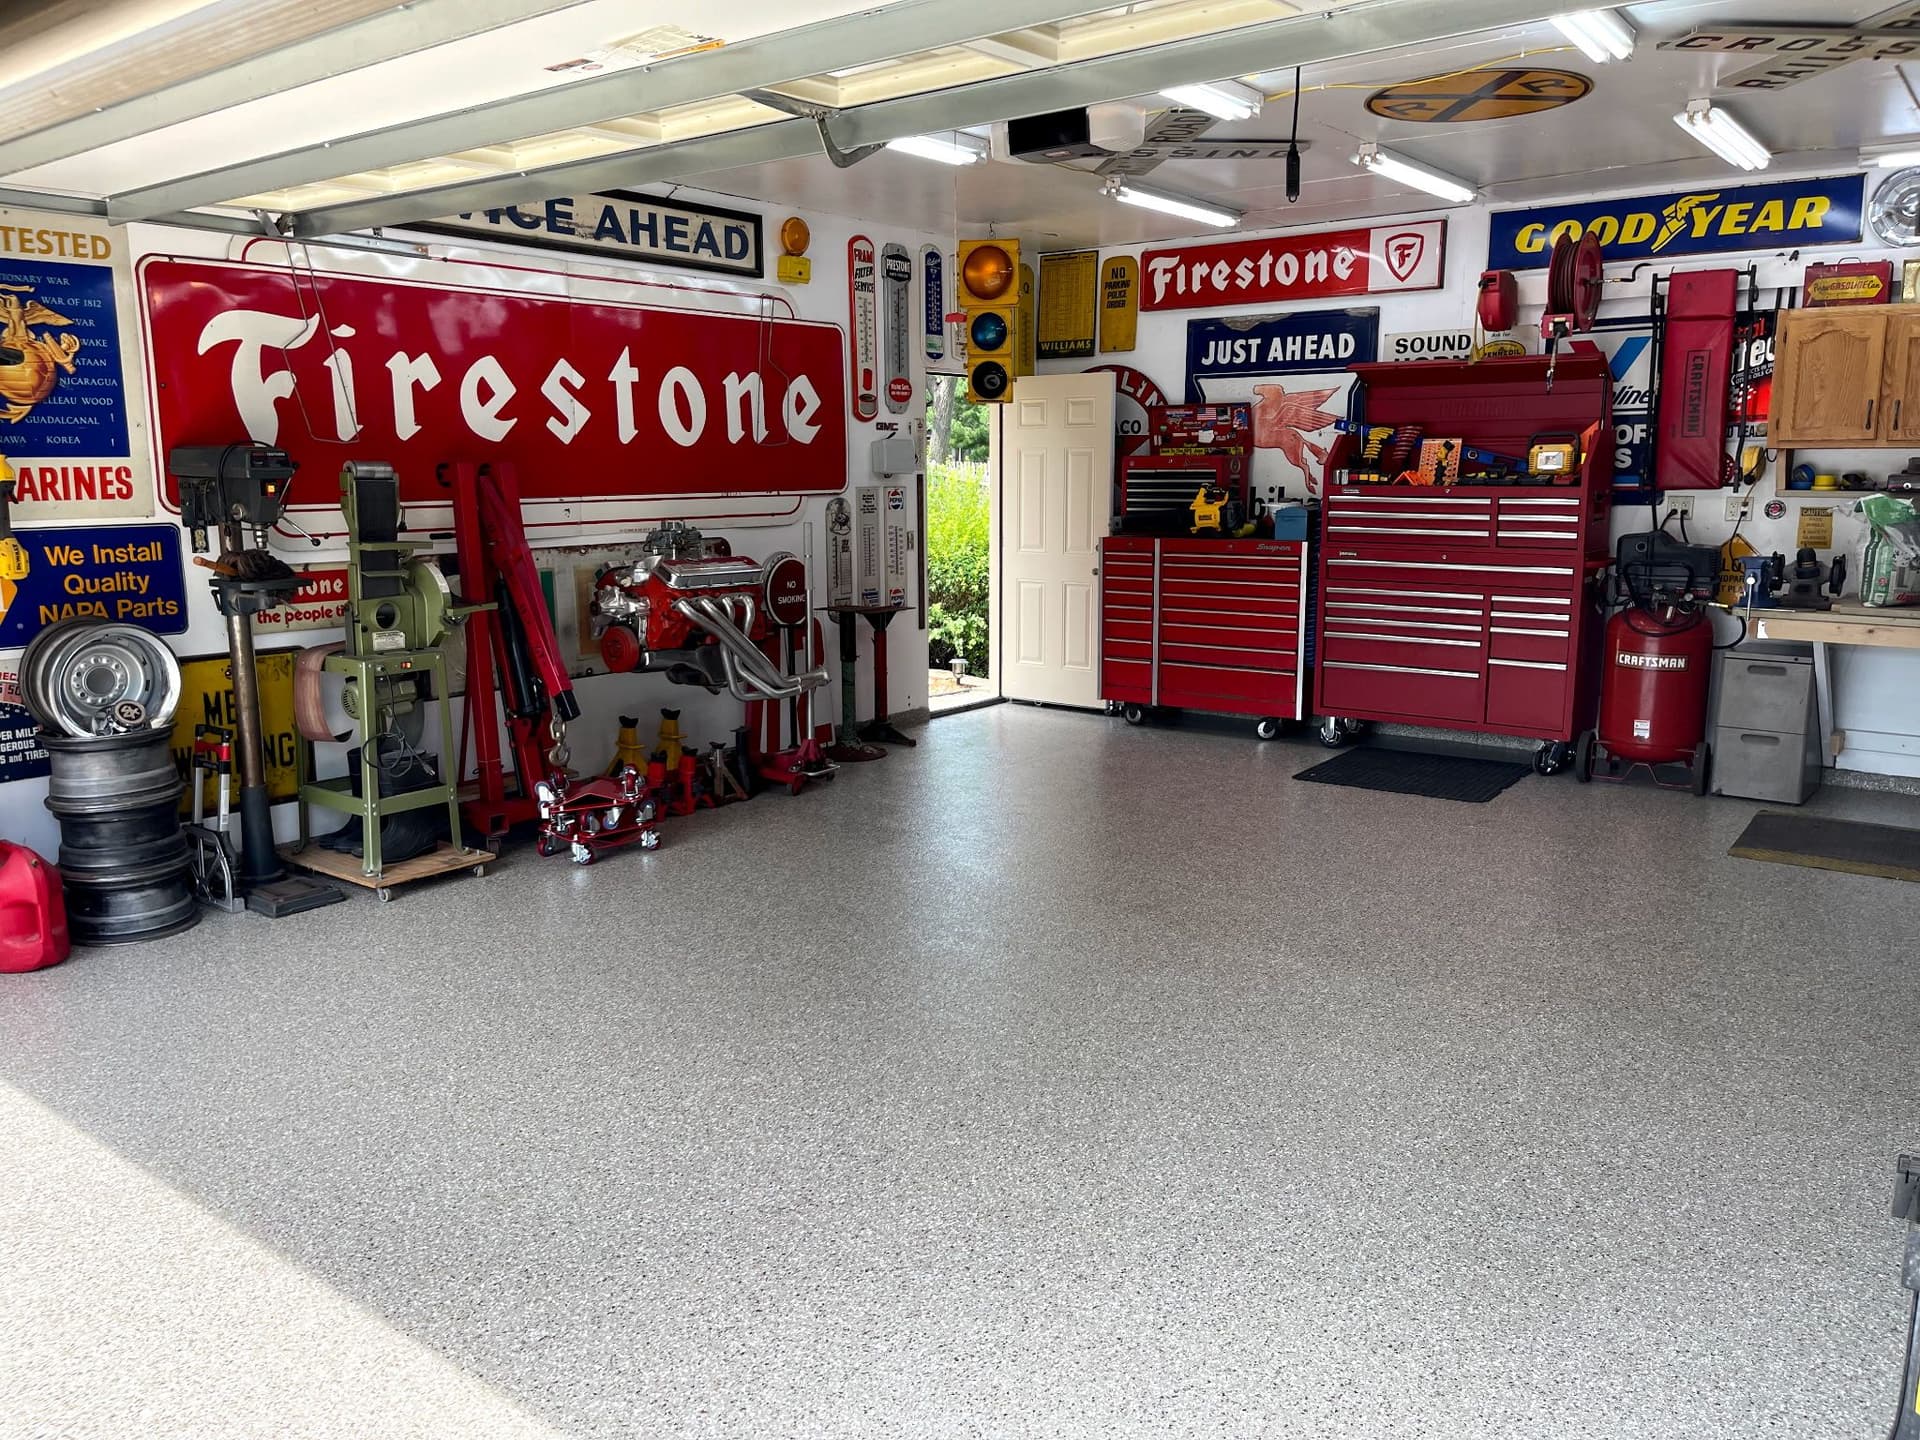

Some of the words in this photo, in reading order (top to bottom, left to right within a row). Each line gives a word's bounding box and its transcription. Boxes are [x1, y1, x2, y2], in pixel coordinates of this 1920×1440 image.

[594, 205, 751, 260] AHEAD
[0, 225, 112, 260] TESTED
[854, 248, 873, 264] FRAM
[855, 266, 874, 279] FILTER
[1112, 267, 1126, 280] NO
[1149, 249, 1358, 305] Firestone
[46, 277, 70, 286] WAR
[855, 281, 874, 293] SERVICE
[1104, 280, 1131, 290] PARKING
[41, 296, 65, 306] WAR
[67, 297, 81, 307] OF
[84, 299, 102, 308] 1812
[1107, 290, 1127, 300] POLICE
[1041, 340, 1092, 351] WILLIAMS
[1201, 339, 1262, 366] JUST
[1267, 333, 1356, 363] AHEAD
[1395, 334, 1472, 354] SOUND
[59, 376, 118, 387] NICARAGUA
[197, 309, 823, 448] Firestone
[1687, 354, 1705, 433] CRAFTSMAN
[82, 397, 114, 406] WOOD
[25, 415, 101, 425] GUADALCANAL
[46, 436, 81, 445] KOREA
[1615, 424, 1647, 445] OF
[10, 466, 134, 502] ARINES
[44, 545, 86, 567] We
[93, 541, 163, 564] Install
[64, 571, 150, 595] Quality
[786, 580, 797, 589] NO
[117, 597, 180, 619] Parts
[257, 610, 281, 624] the
[284, 605, 333, 624] people
[1619, 653, 1686, 668] CRAFTSMAN
[9, 753, 23, 763] and
[24, 749, 50, 761] TIRES
